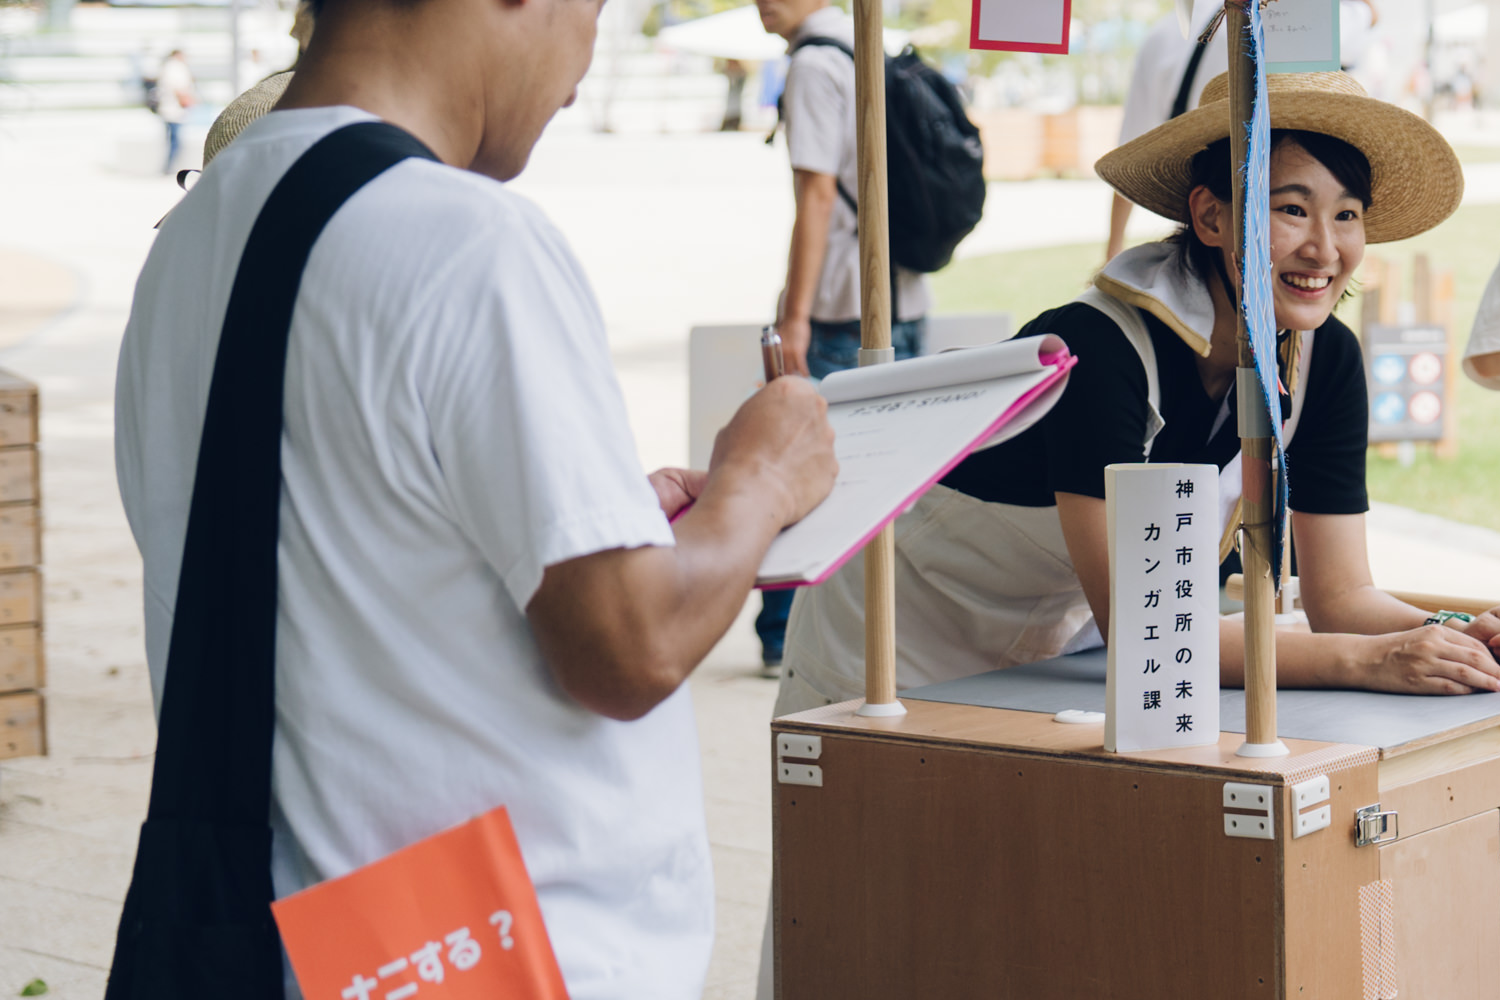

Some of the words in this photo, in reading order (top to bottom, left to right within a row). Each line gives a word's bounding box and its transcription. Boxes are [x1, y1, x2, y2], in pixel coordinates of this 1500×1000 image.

[1142, 522, 1162, 711] カンガエル課
[1174, 479, 1195, 733] 神戸市役所の未来
